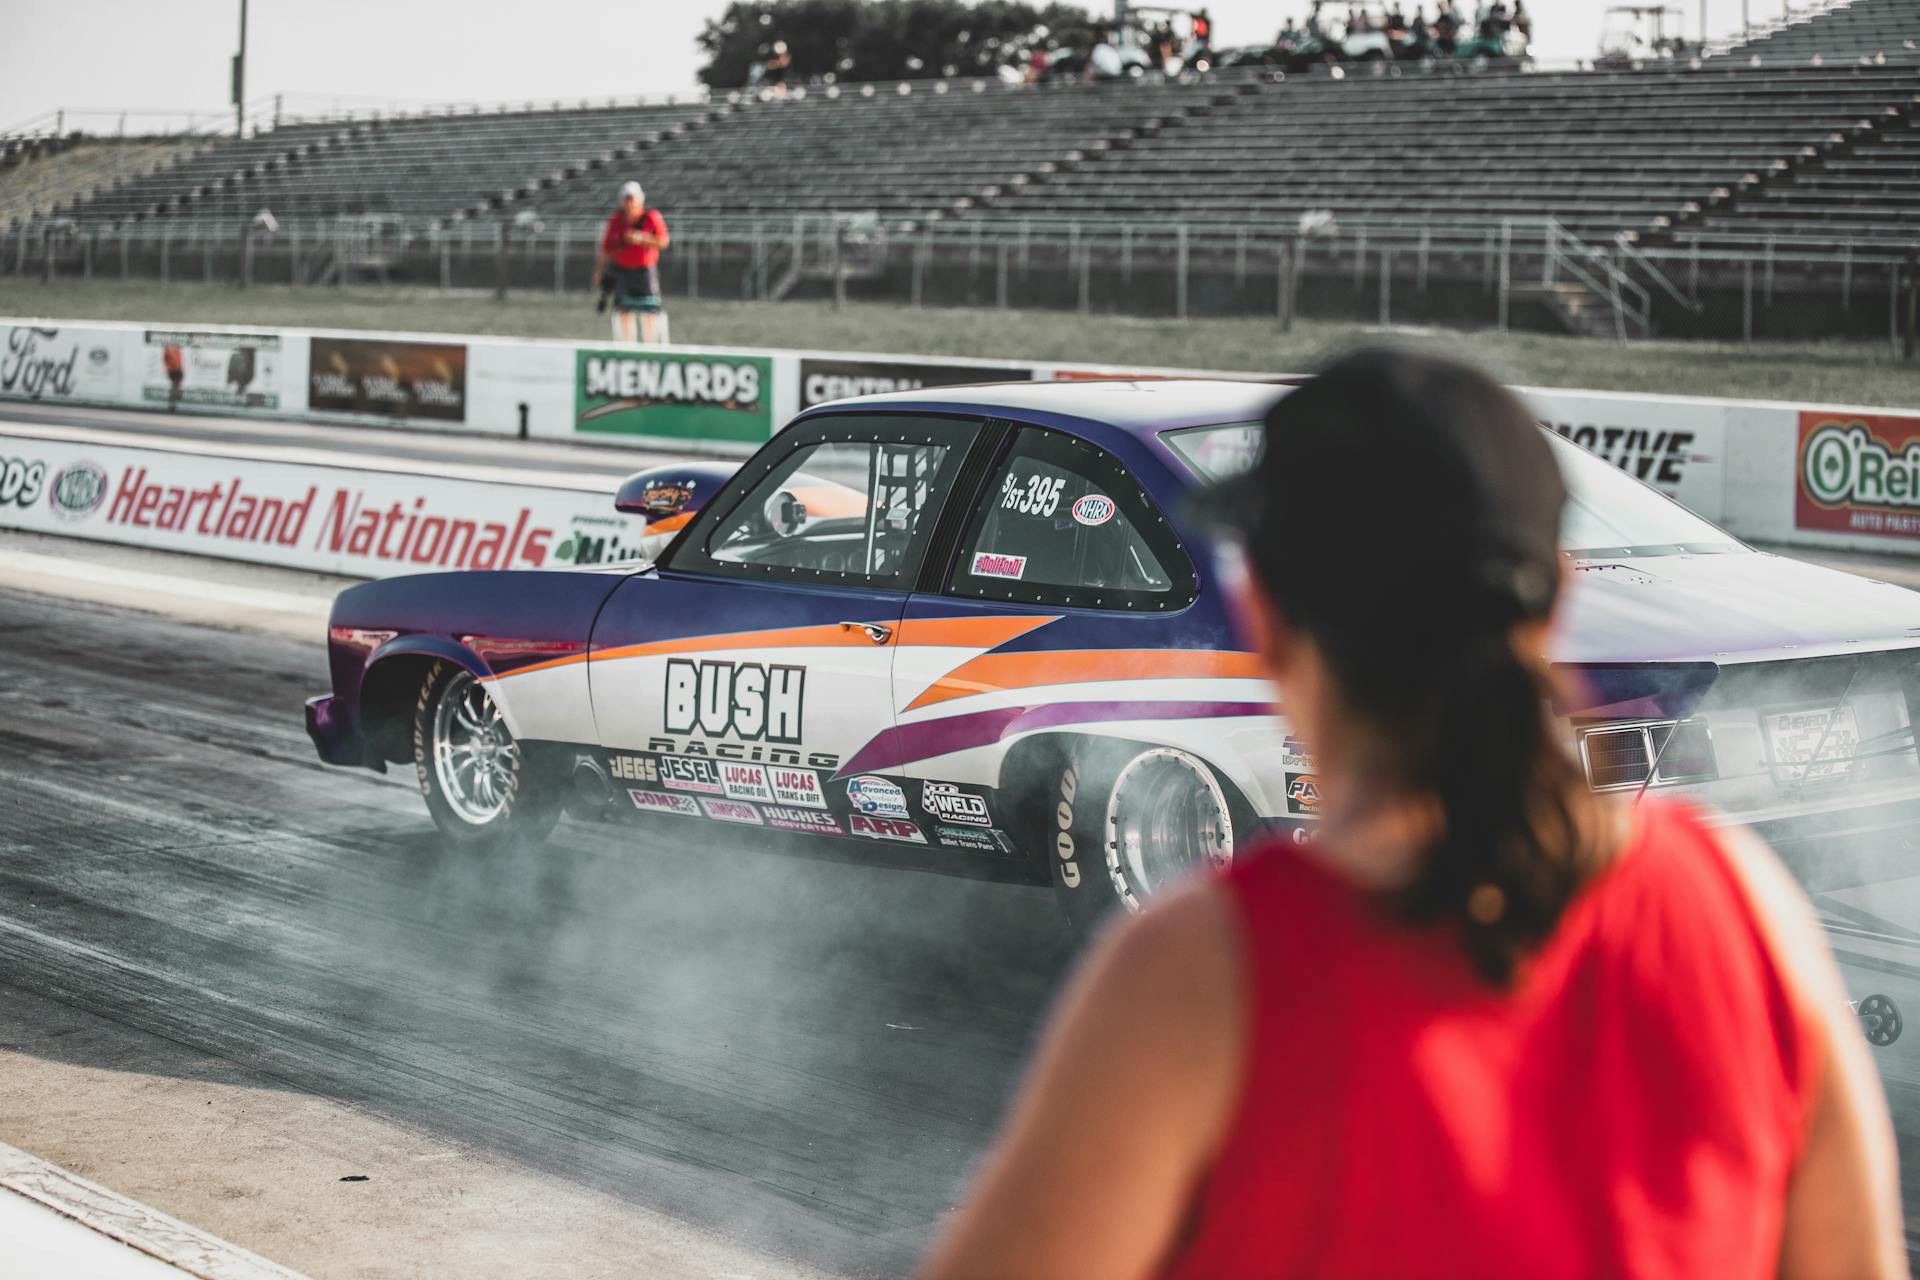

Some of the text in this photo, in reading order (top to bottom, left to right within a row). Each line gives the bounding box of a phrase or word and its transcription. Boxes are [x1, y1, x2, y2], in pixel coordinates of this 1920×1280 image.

[2, 325, 77, 400] Ford
[585, 357, 761, 404] MENARDS
[1018, 475, 1066, 517] 395
[107, 466, 554, 571] Heartland Nationals
[1079, 500, 1109, 519] NHRA
[664, 658, 806, 745] BUSH
[609, 756, 658, 781] JEGS
[660, 757, 721, 785] JESEL
[725, 766, 762, 786] LUCAS
[729, 784, 754, 796] RACING
[756, 787, 767, 798] OIL
[775, 771, 814, 792] LUCAS
[632, 791, 681, 807] COMP
[777, 790, 798, 801] TRANS
[806, 793, 820, 803] DIFF
[935, 795, 985, 816] WELD
[761, 806, 836, 826] HUGHES
[771, 819, 842, 834] CONVERTERS
[850, 815, 918, 838] ARP
[942, 812, 988, 823] RACING
